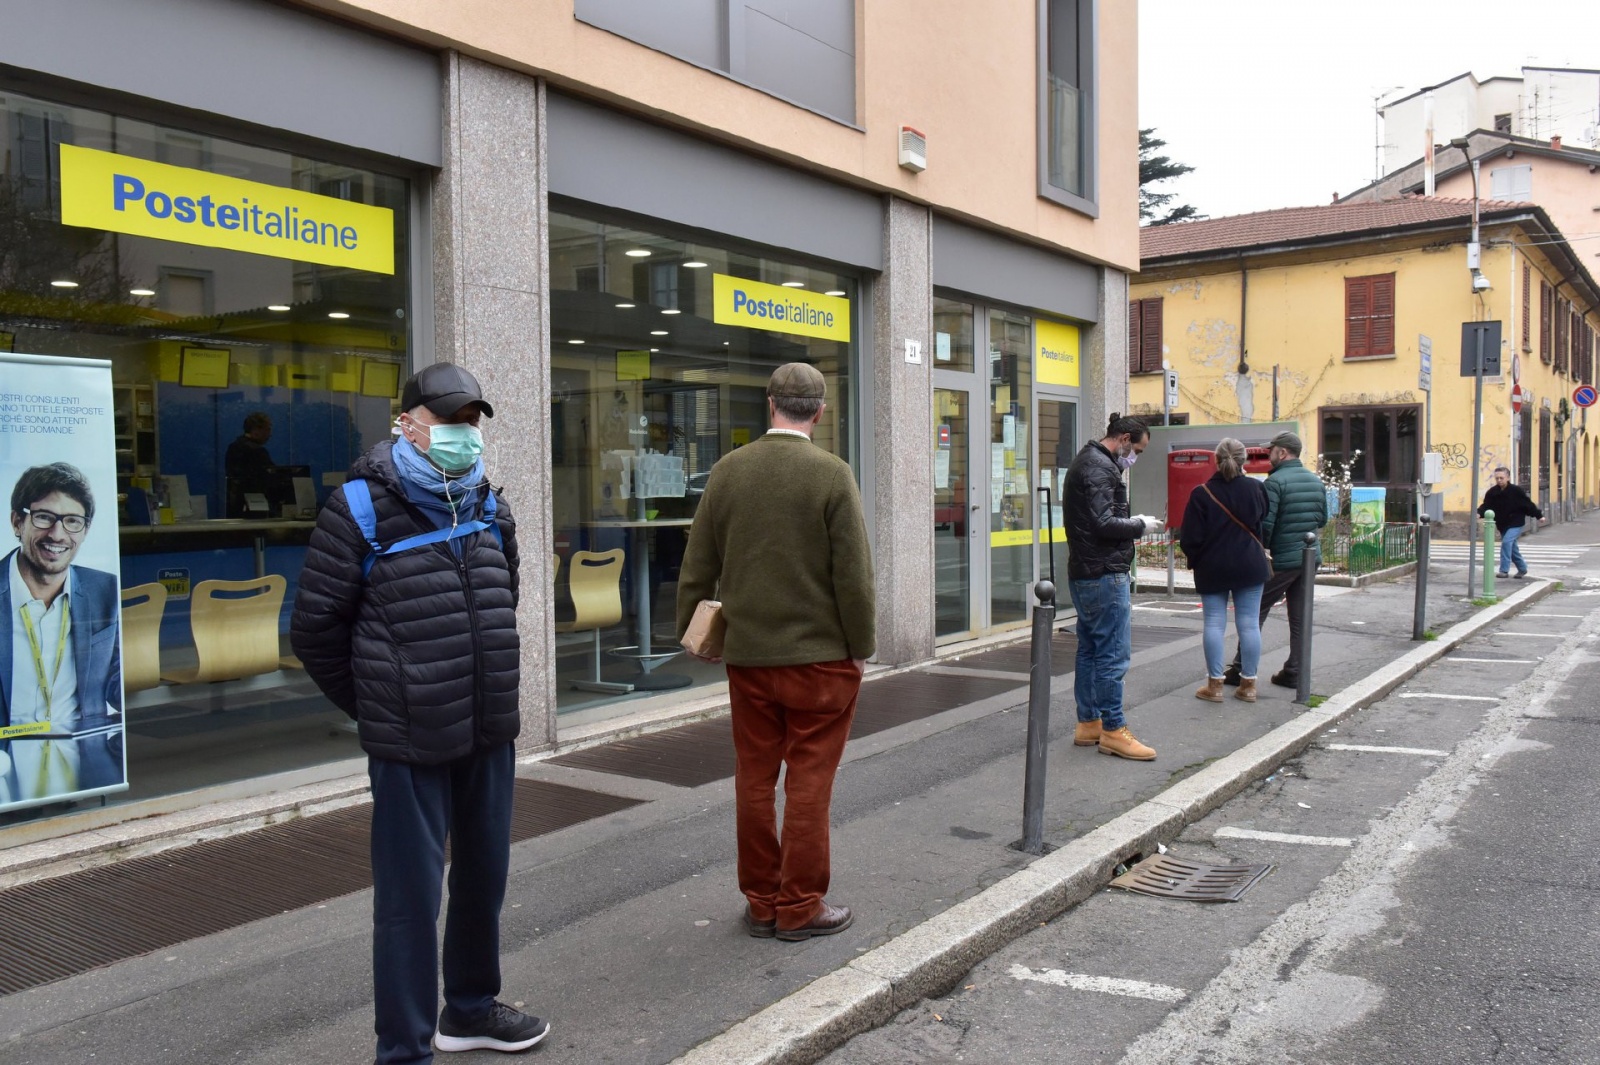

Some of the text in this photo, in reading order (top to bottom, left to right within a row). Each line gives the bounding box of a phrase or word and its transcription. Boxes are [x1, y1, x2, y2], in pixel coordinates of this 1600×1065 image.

[113, 173, 358, 250] Posteitaliane
[733, 289, 834, 328] Posteitaliane
[25, 395, 80, 405] CONSULENTI
[20, 404, 49, 414] TUTTE
[50, 406, 60, 414] LE
[63, 407, 104, 416] RISPOSTE
[24, 415, 50, 424] SONO
[52, 416, 87, 425] ATTENTI
[10, 425, 27, 433] TUE
